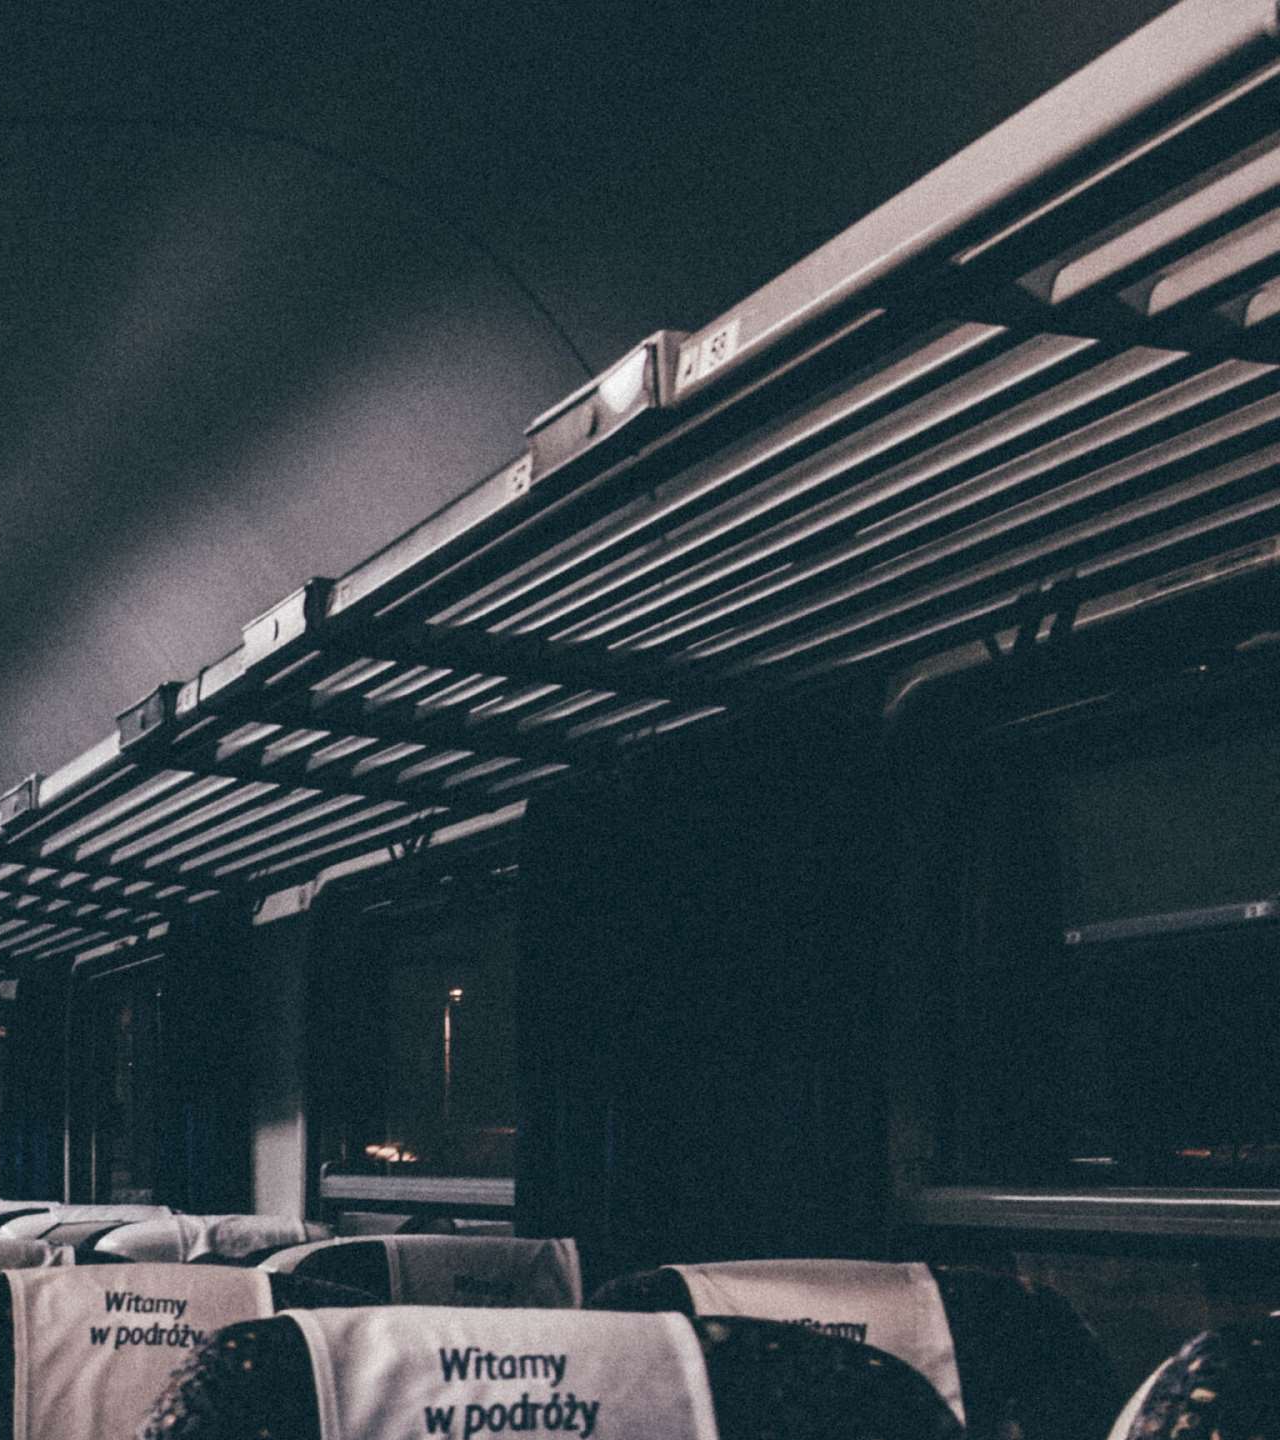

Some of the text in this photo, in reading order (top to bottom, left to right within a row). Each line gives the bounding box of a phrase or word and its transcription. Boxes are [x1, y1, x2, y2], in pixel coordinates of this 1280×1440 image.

[104, 1291, 188, 1319] Witamy
[89, 1326, 111, 1346] w
[439, 1346, 567, 1388] Witamy
[423, 1404, 456, 1435] w
